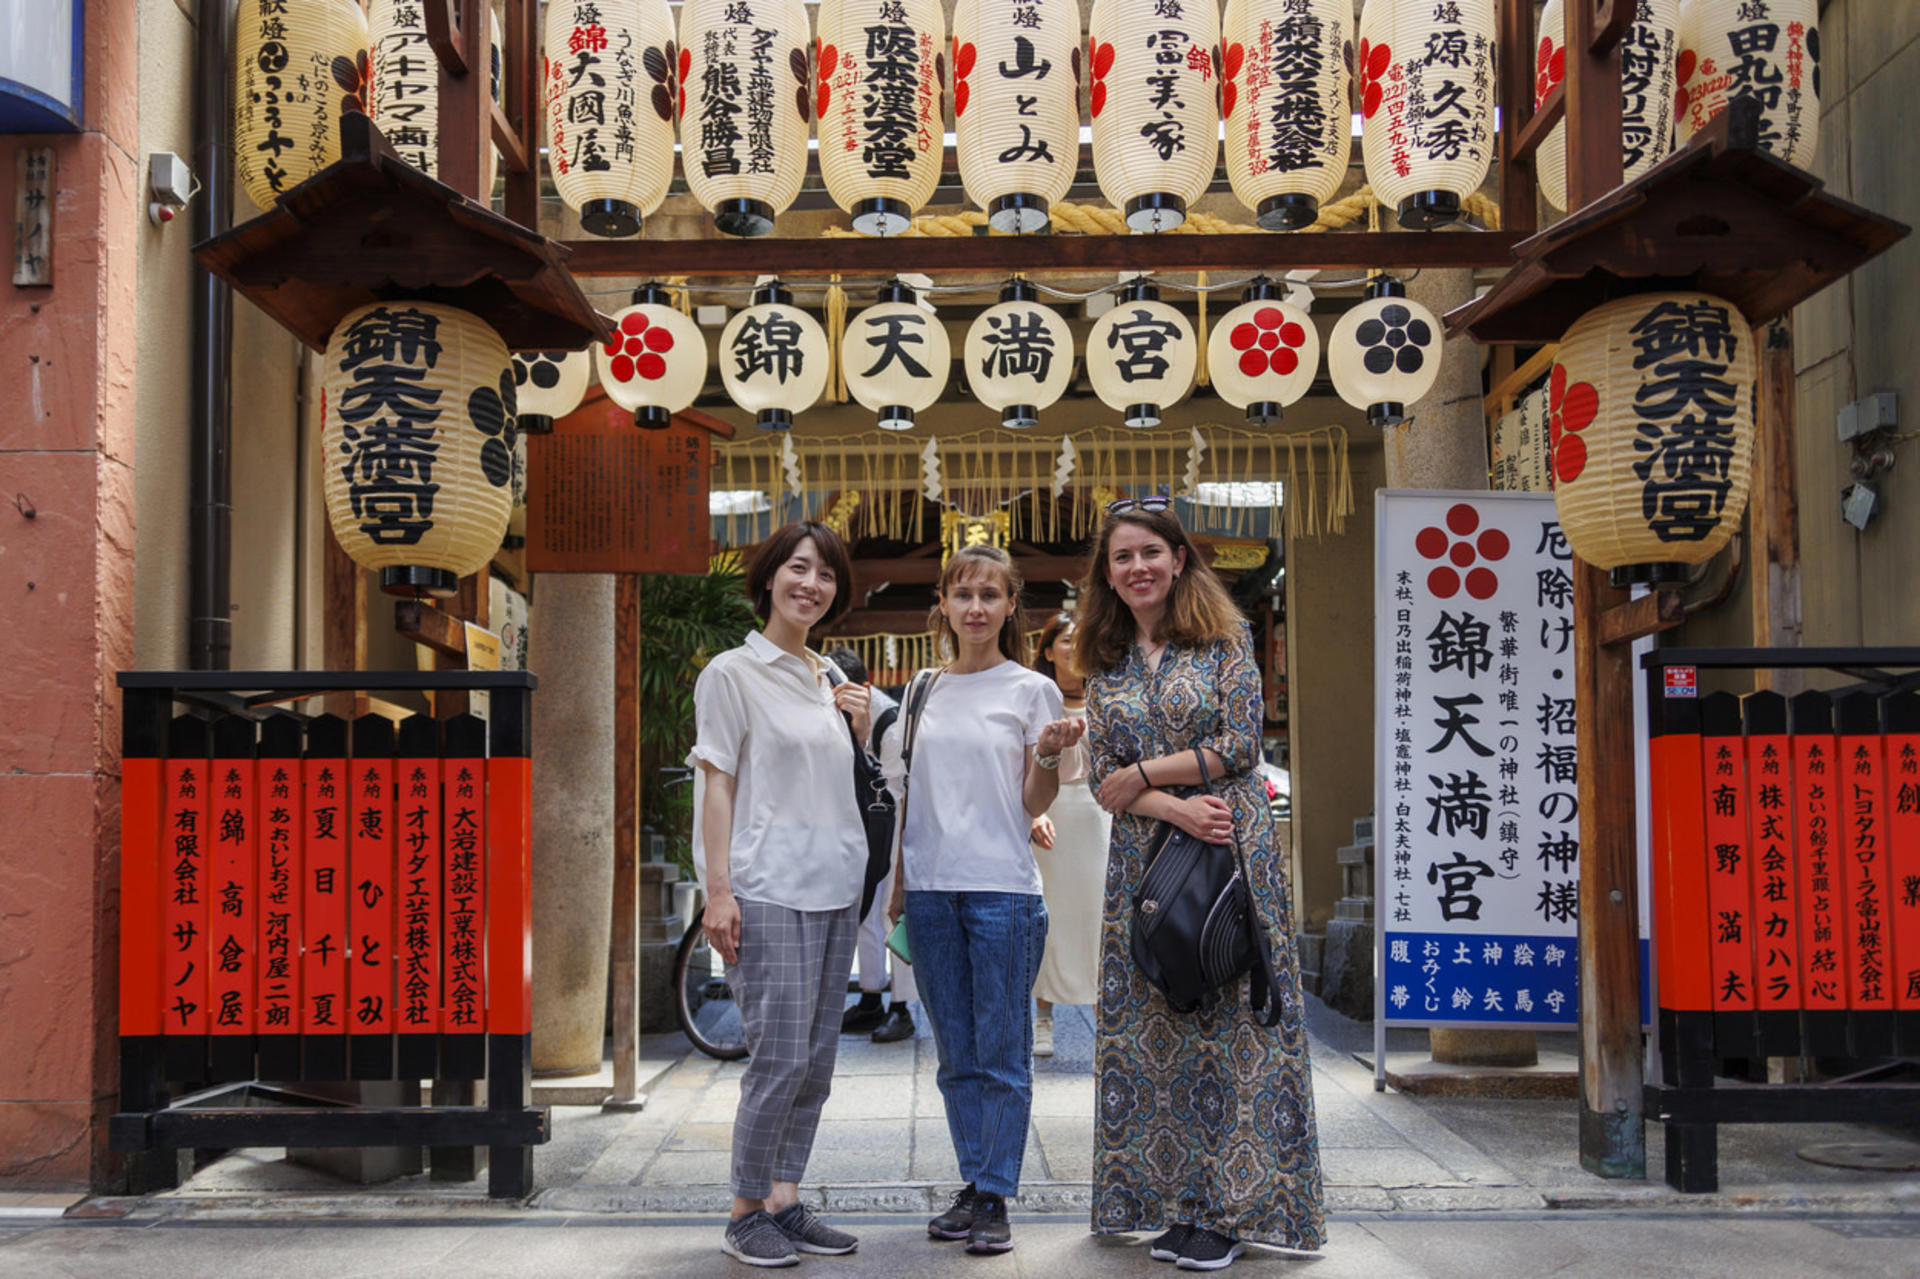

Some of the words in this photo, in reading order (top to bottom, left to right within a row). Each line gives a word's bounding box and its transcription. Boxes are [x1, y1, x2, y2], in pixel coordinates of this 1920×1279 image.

[614, 29, 637, 163] うなぎ川魚専門
[1186, 44, 1212, 83] 錦
[1423, 30, 1471, 160] 源久秀
[700, 62, 742, 178] 熊谷勝昌
[747, 27, 778, 174] ダイヤ土地建物有限会社
[863, 24, 919, 179] 阪本漢方堂
[998, 36, 1054, 163] 山とみ
[731, 311, 805, 385] 錦
[861, 313, 932, 378] 天
[982, 310, 1055, 383] 満
[1108, 309, 1183, 383] 宮
[339, 307, 444, 545] 錦天満宮
[1629, 300, 1738, 543] 錦天満宮
[1535, 522, 1579, 923] 厄除け・招福の神様
[178, 767, 197, 799] 奉納
[224, 767, 243, 799] 奉納
[271, 767, 289, 799] 奉納
[317, 767, 335, 799] 奉納
[363, 767, 380, 799] 奉納
[410, 767, 428, 799] 奉納
[455, 767, 473, 799] 奉納
[1425, 610, 1495, 922] 錦天満宮
[1716, 745, 1733, 776] 奉納
[1762, 743, 1779, 775] 奉納
[1808, 743, 1825, 775] 奉納
[1854, 745, 1871, 776] 奉納
[1900, 743, 1918, 774] 奉納
[405, 805, 430, 1025] オサダ工芸株式会社
[450, 807, 478, 1026] 大岩建設工業株式会社
[1854, 783, 1885, 1002] トヨタカローラ富山株式会社
[1390, 940, 1411, 1009] 腹帯
[1422, 940, 1440, 1012] おみくじ
[1451, 942, 1474, 1010] 土鈴
[1483, 942, 1504, 1011] 神矢
[1513, 943, 1535, 1012] 絵馬
[1544, 944, 1565, 1013] 御守
